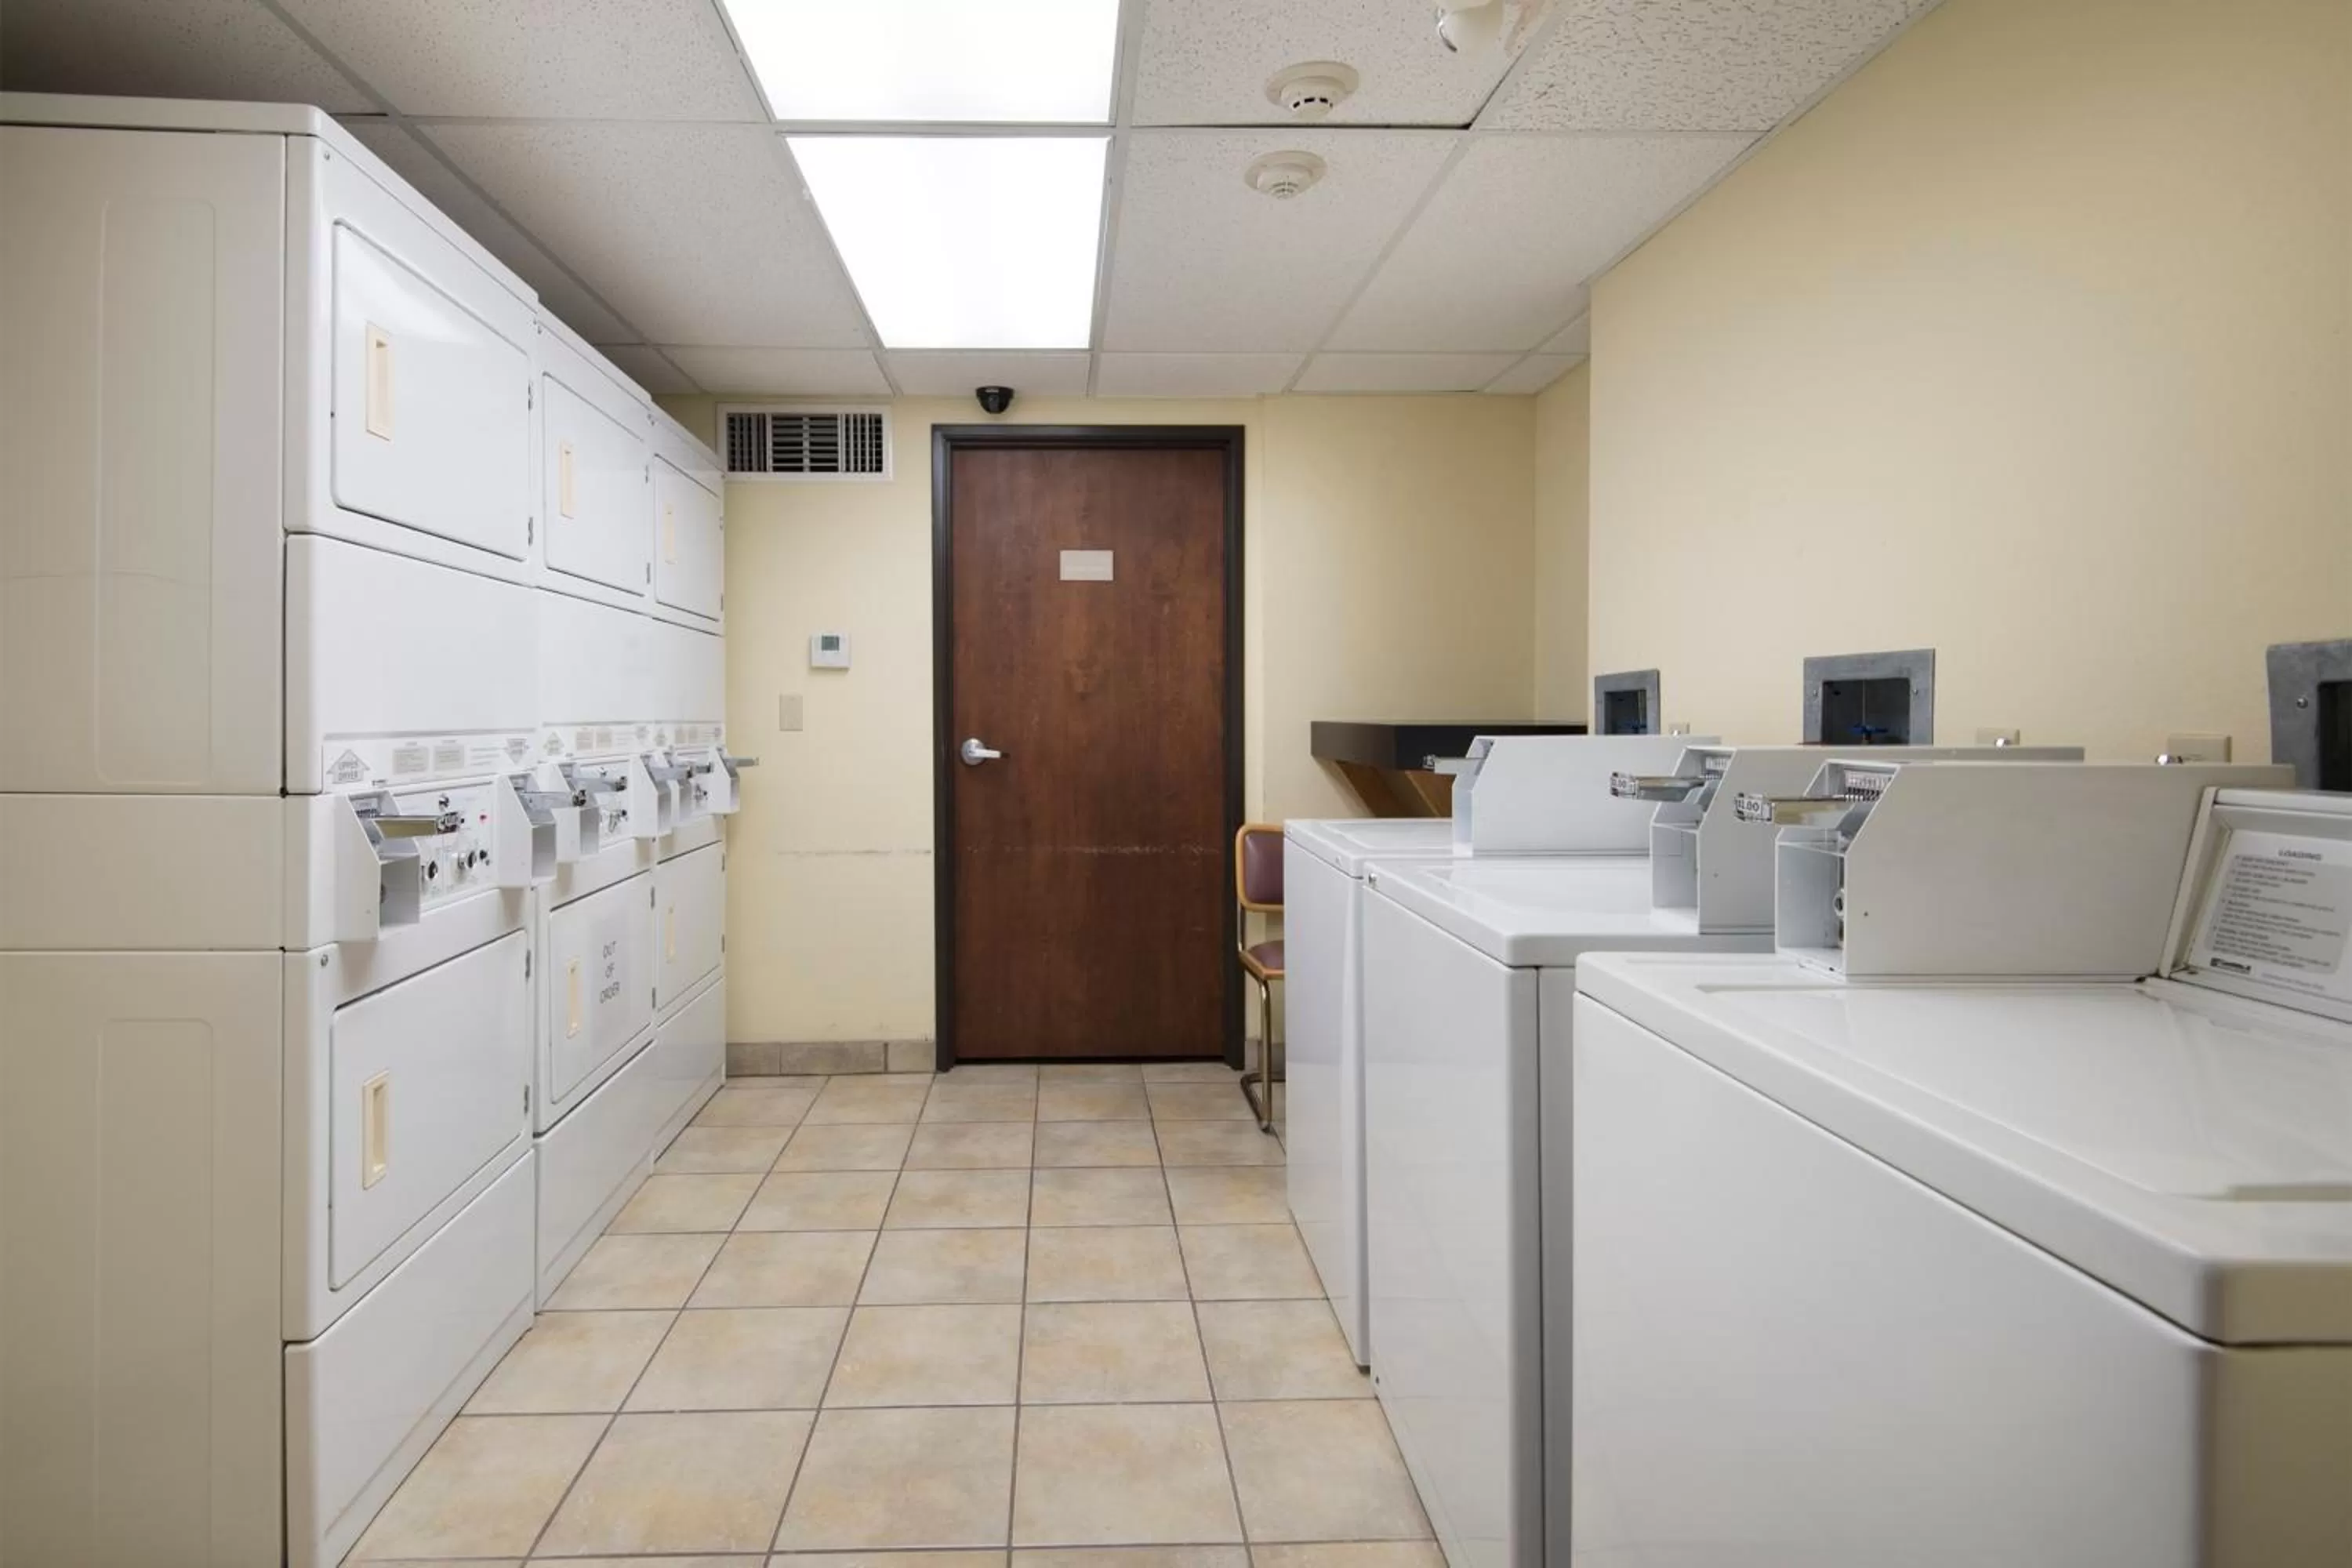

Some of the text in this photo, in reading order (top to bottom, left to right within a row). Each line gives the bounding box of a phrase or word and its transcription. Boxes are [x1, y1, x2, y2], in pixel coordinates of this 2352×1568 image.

[602, 940, 617, 960] OUT
[604, 962, 615, 978] OF
[599, 981, 620, 1004] ORDER
